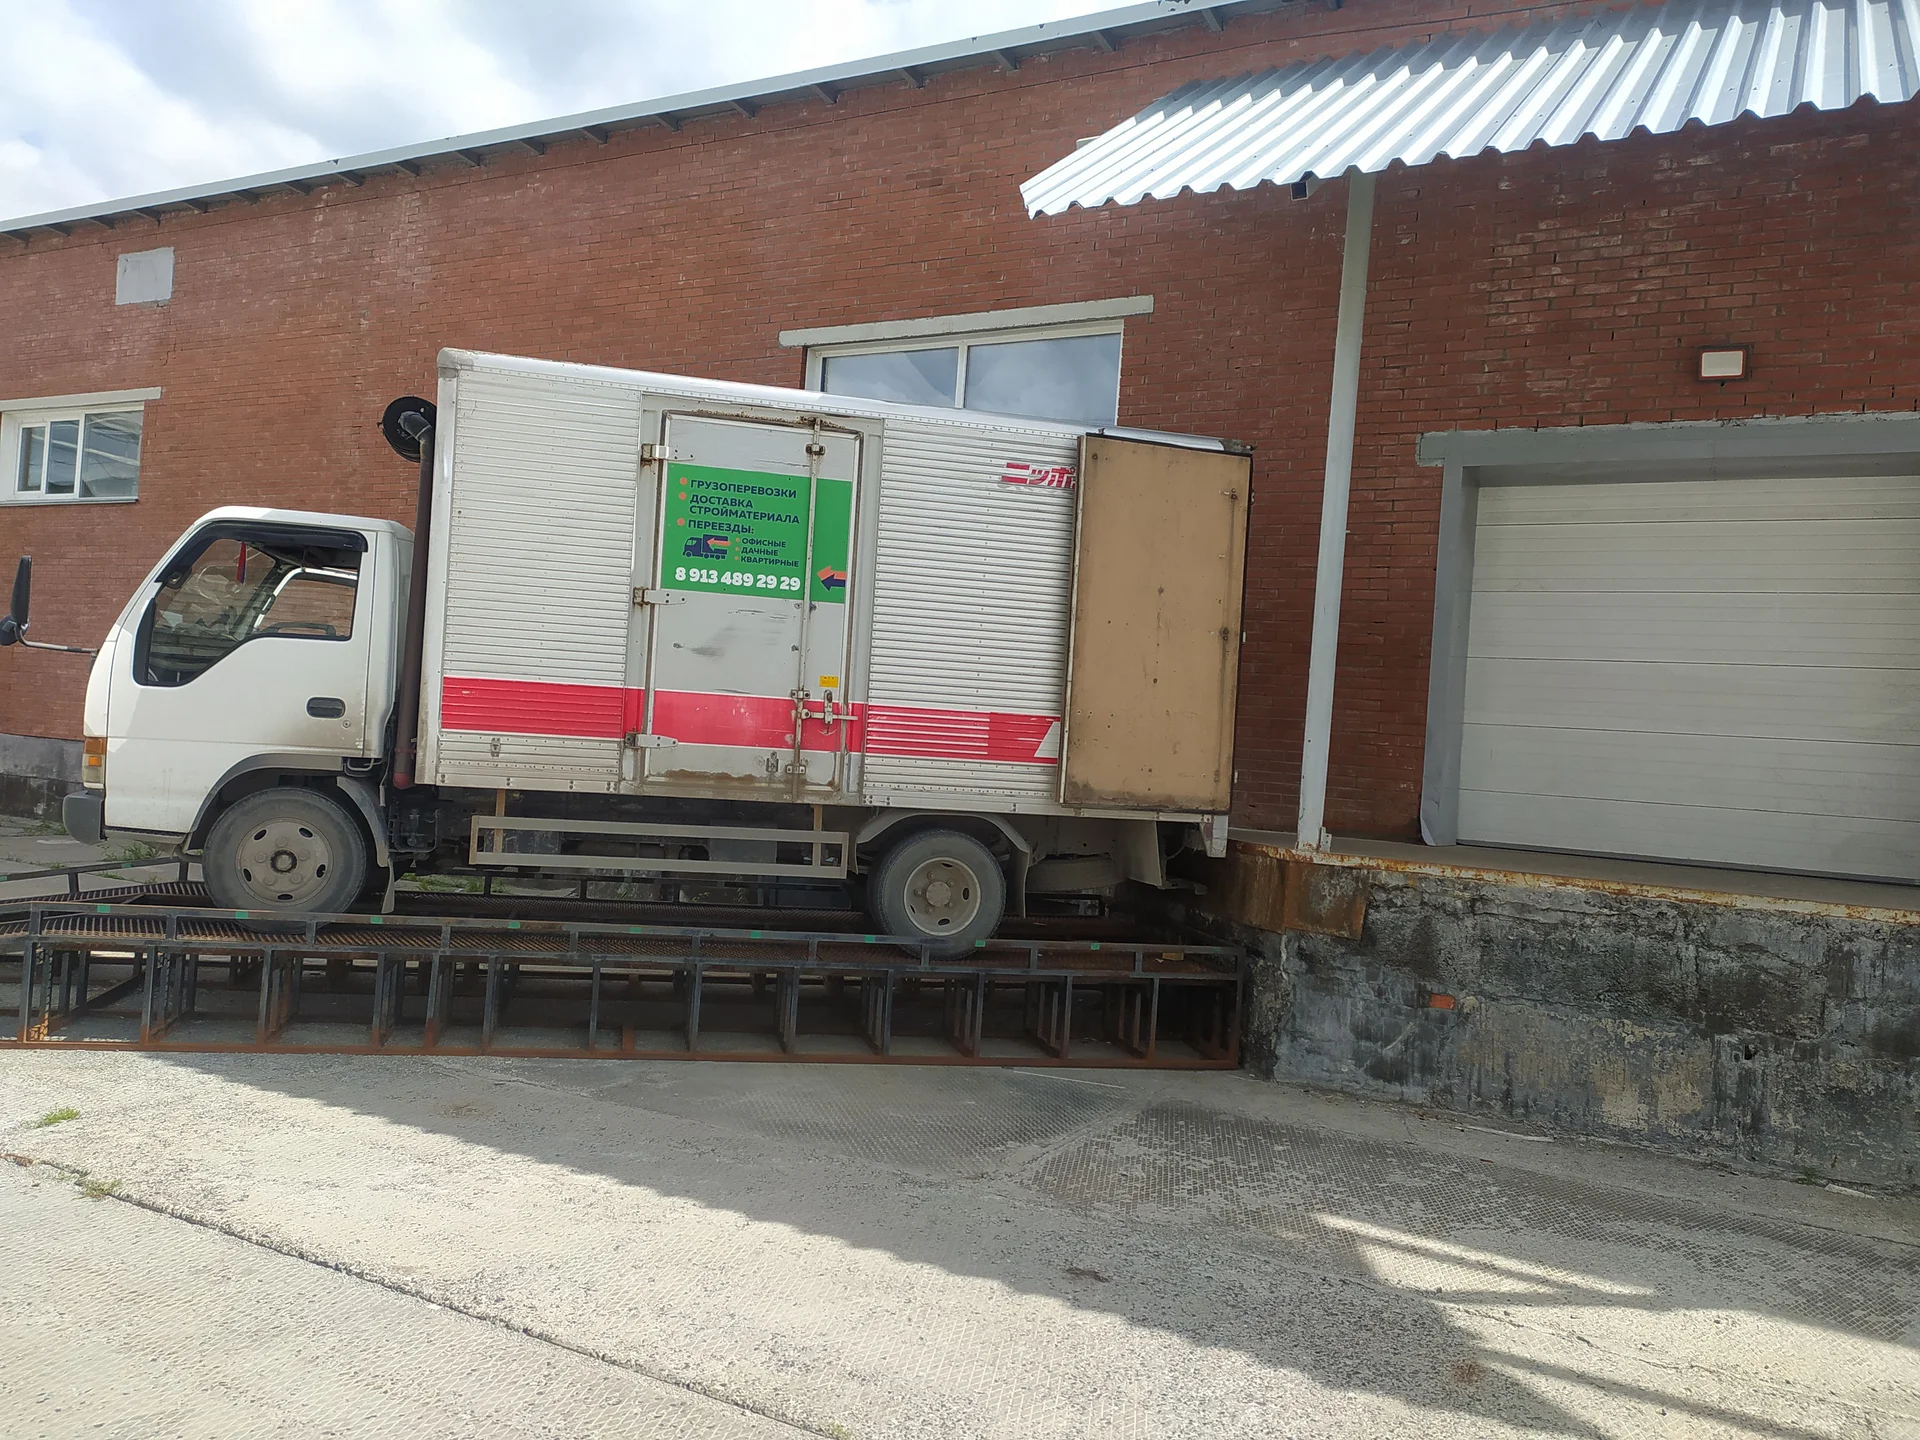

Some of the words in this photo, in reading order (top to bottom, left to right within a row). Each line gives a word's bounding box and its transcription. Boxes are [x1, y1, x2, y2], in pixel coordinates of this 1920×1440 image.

[1001, 462, 1076, 491] ニッポ
[690, 480, 797, 498] ГРУЗОПЕРЕВОЗКИ
[690, 494, 753, 509] ДОСТАВКА
[689, 505, 800, 524] СТРОЙМАТЕРИАЛА
[688, 519, 754, 534] ПЕРЕЕЗДЫ:
[741, 537, 787, 548] ОФИСНЫЕ
[741, 547, 779, 556] ДАЧНЫЕ
[741, 556, 799, 567] КВАРТИРНЫЕ
[675, 567, 686, 581] 8
[689, 568, 718, 583] 913
[721, 571, 754, 587] 489
[756, 574, 777, 589] 29
[780, 576, 801, 591] 29
